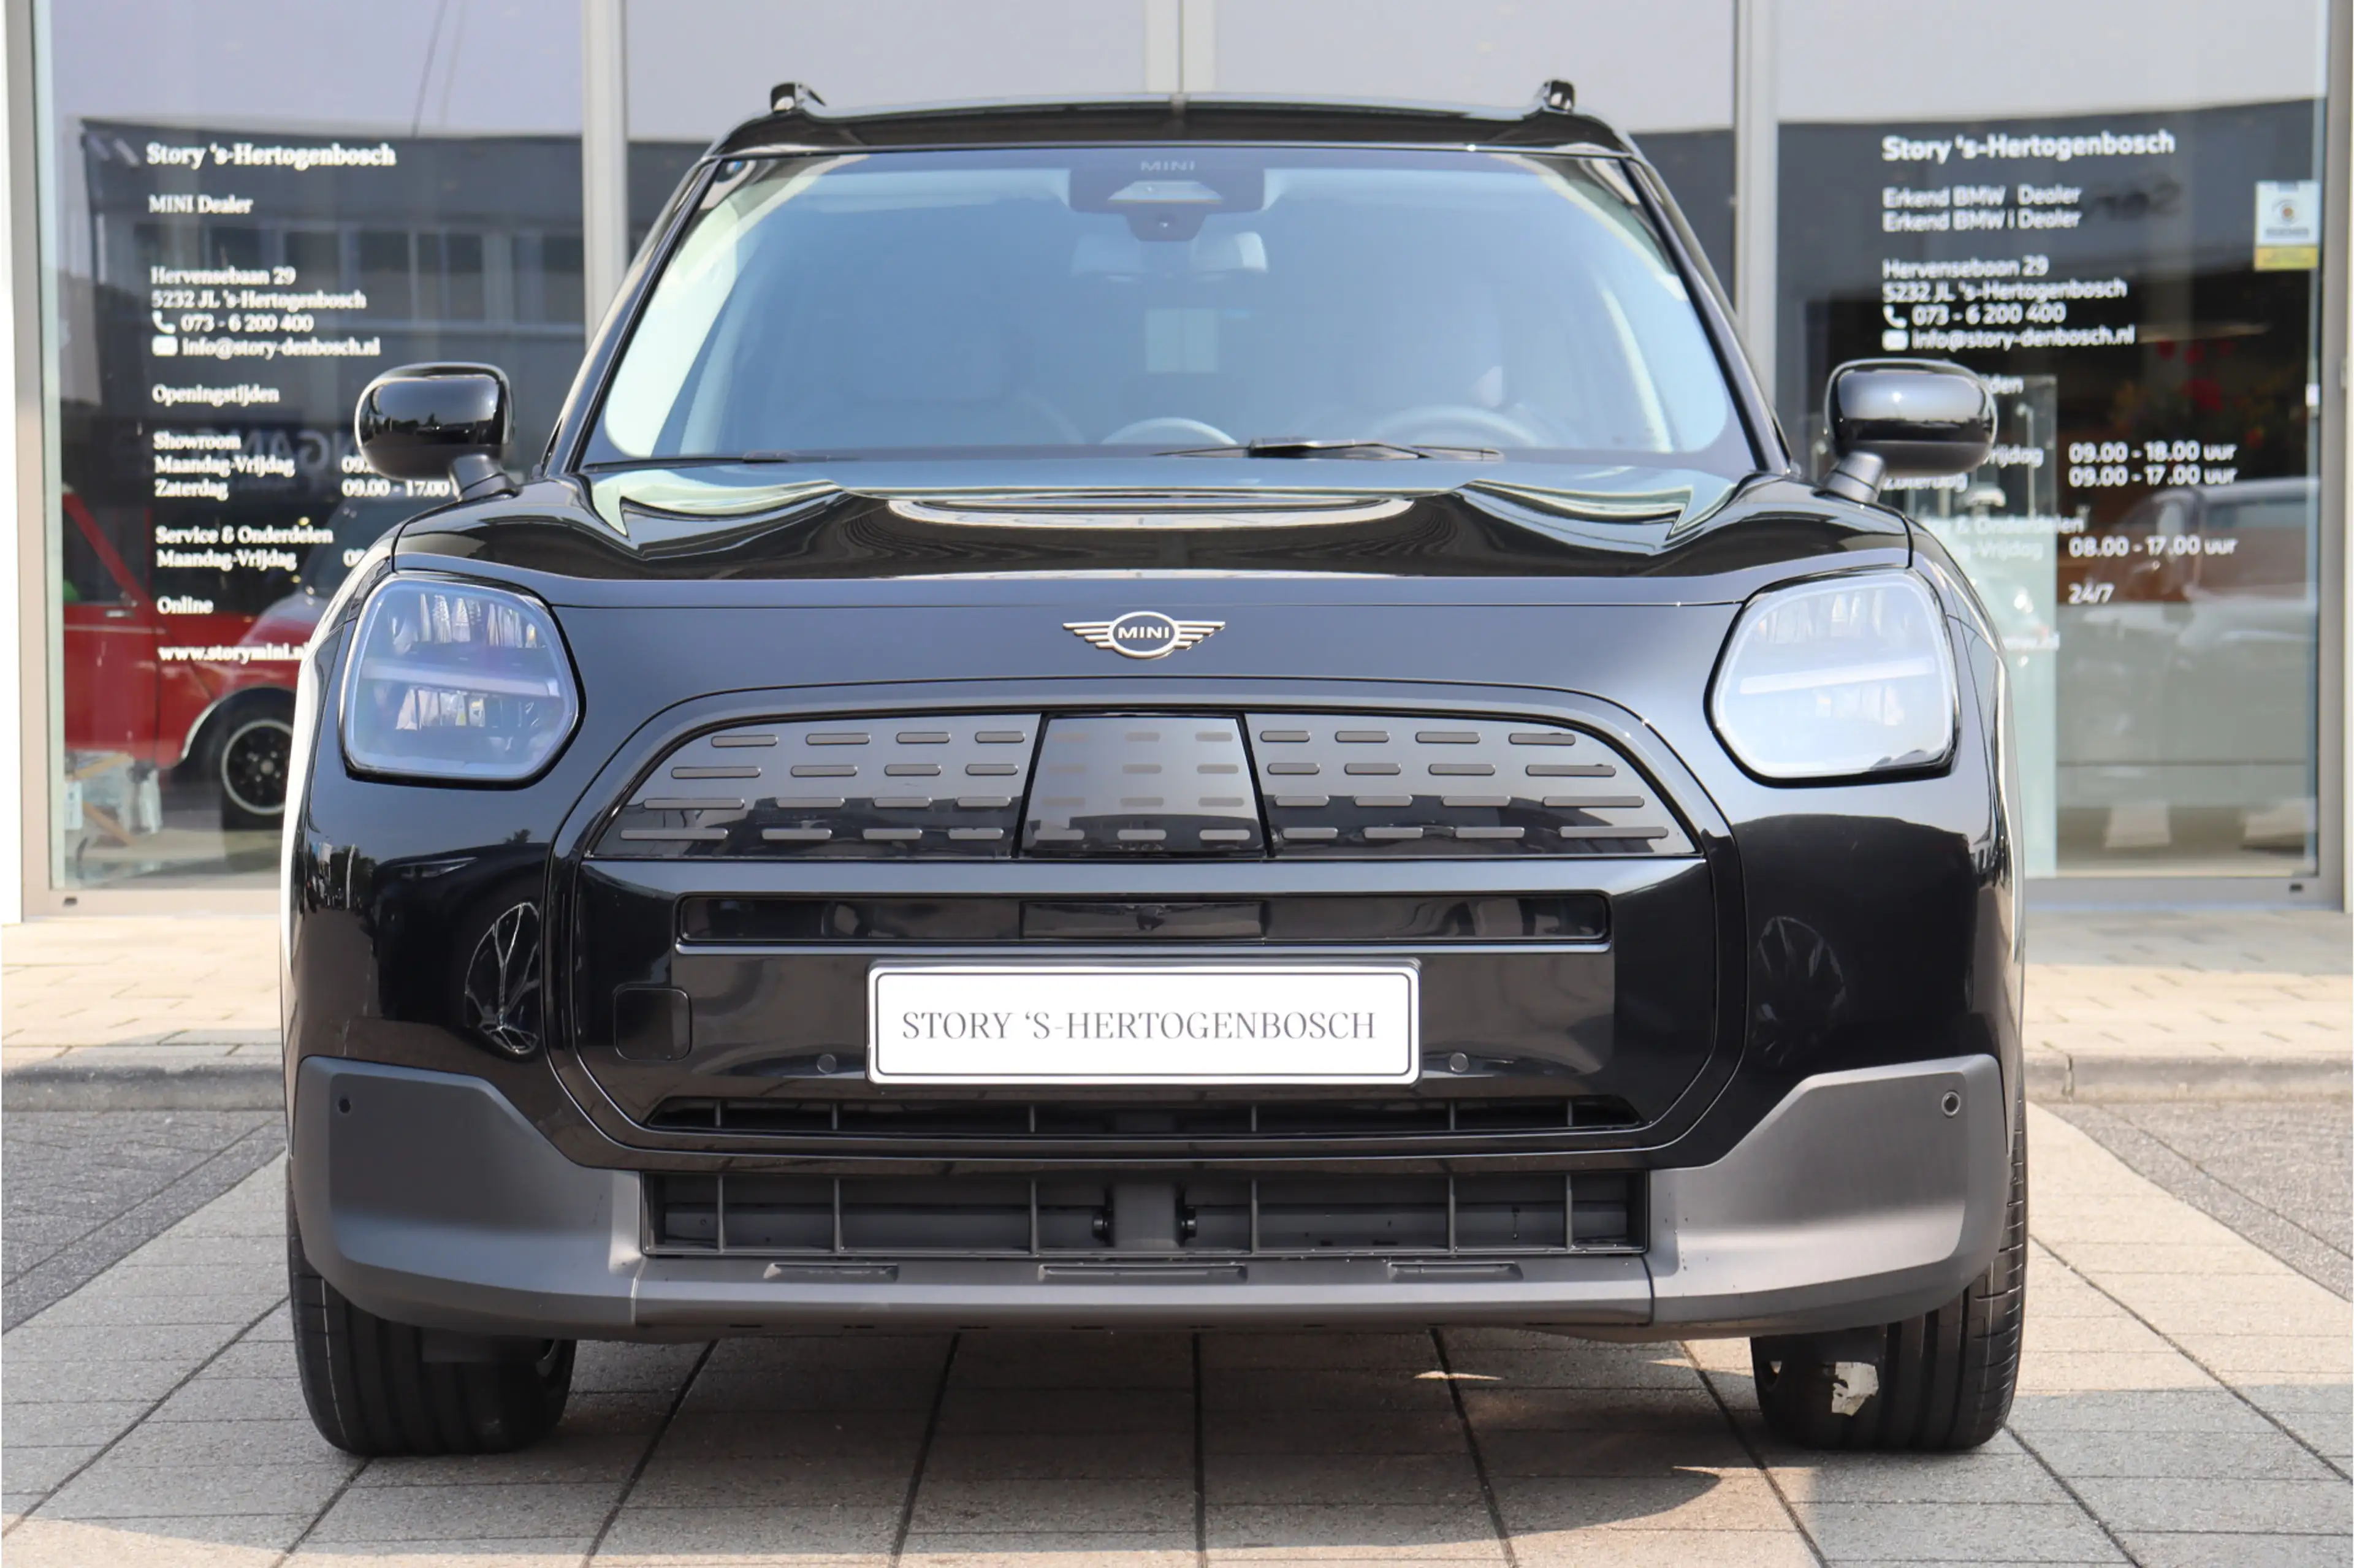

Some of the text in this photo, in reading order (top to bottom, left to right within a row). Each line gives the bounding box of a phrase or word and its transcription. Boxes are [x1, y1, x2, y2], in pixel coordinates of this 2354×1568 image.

[147, 142, 206, 170] Story
[1882, 135, 1952, 165] Story
[1141, 161, 1195, 171] MINI
[149, 194, 253, 214] MINI Dealer
[1882, 183, 2082, 208] Erkend BMW Dealer
[1882, 207, 2082, 232] Erkend BMW i Dealer
[151, 265, 296, 285] Hervensebaan 29
[1882, 254, 2049, 279] Hervensebaan 29
[151, 289, 195, 308] 5232
[197, 289, 221, 308] JL
[1882, 281, 1930, 303] 5232
[1933, 280, 1956, 303] JL
[180, 313, 215, 333] 073
[228, 313, 242, 332] 6
[244, 313, 278, 332] 200
[280, 313, 314, 332] 400
[1911, 304, 1949, 326] 073
[1965, 303, 1981, 325] 6
[1982, 302, 2023, 324] 200
[2025, 301, 2066, 323] 400
[182, 337, 381, 360] info@story-denbosch.nl
[1911, 324, 2135, 352] info@story-denbosch.nl
[152, 384, 280, 406] Openingstijden
[153, 432, 242, 450] Showroom
[2068, 442, 2128, 463] 09.00
[2144, 440, 2200, 462] 18.00
[2203, 444, 2238, 461] uur
[154, 454, 295, 478] Maandag-Vrijdag
[2068, 466, 2128, 487] 09.00
[2144, 463, 2201, 485] 17.00
[2204, 468, 2238, 485] uur
[154, 478, 229, 501] Zaterdag
[341, 478, 390, 497] 09.00
[405, 479, 451, 497] 17.00
[155, 525, 219, 544] Service
[237, 525, 333, 544] Onderdelen
[2068, 536, 2130, 557] 08.00
[2144, 534, 2201, 556] 17.00
[2204, 538, 2239, 555] uur
[156, 549, 297, 571] Maandag-Vrijdag
[157, 595, 214, 614] Online
[2068, 582, 2115, 604] 24/7
[1118, 626, 1169, 639] MINI
[903, 1012, 1015, 1039] STORY
